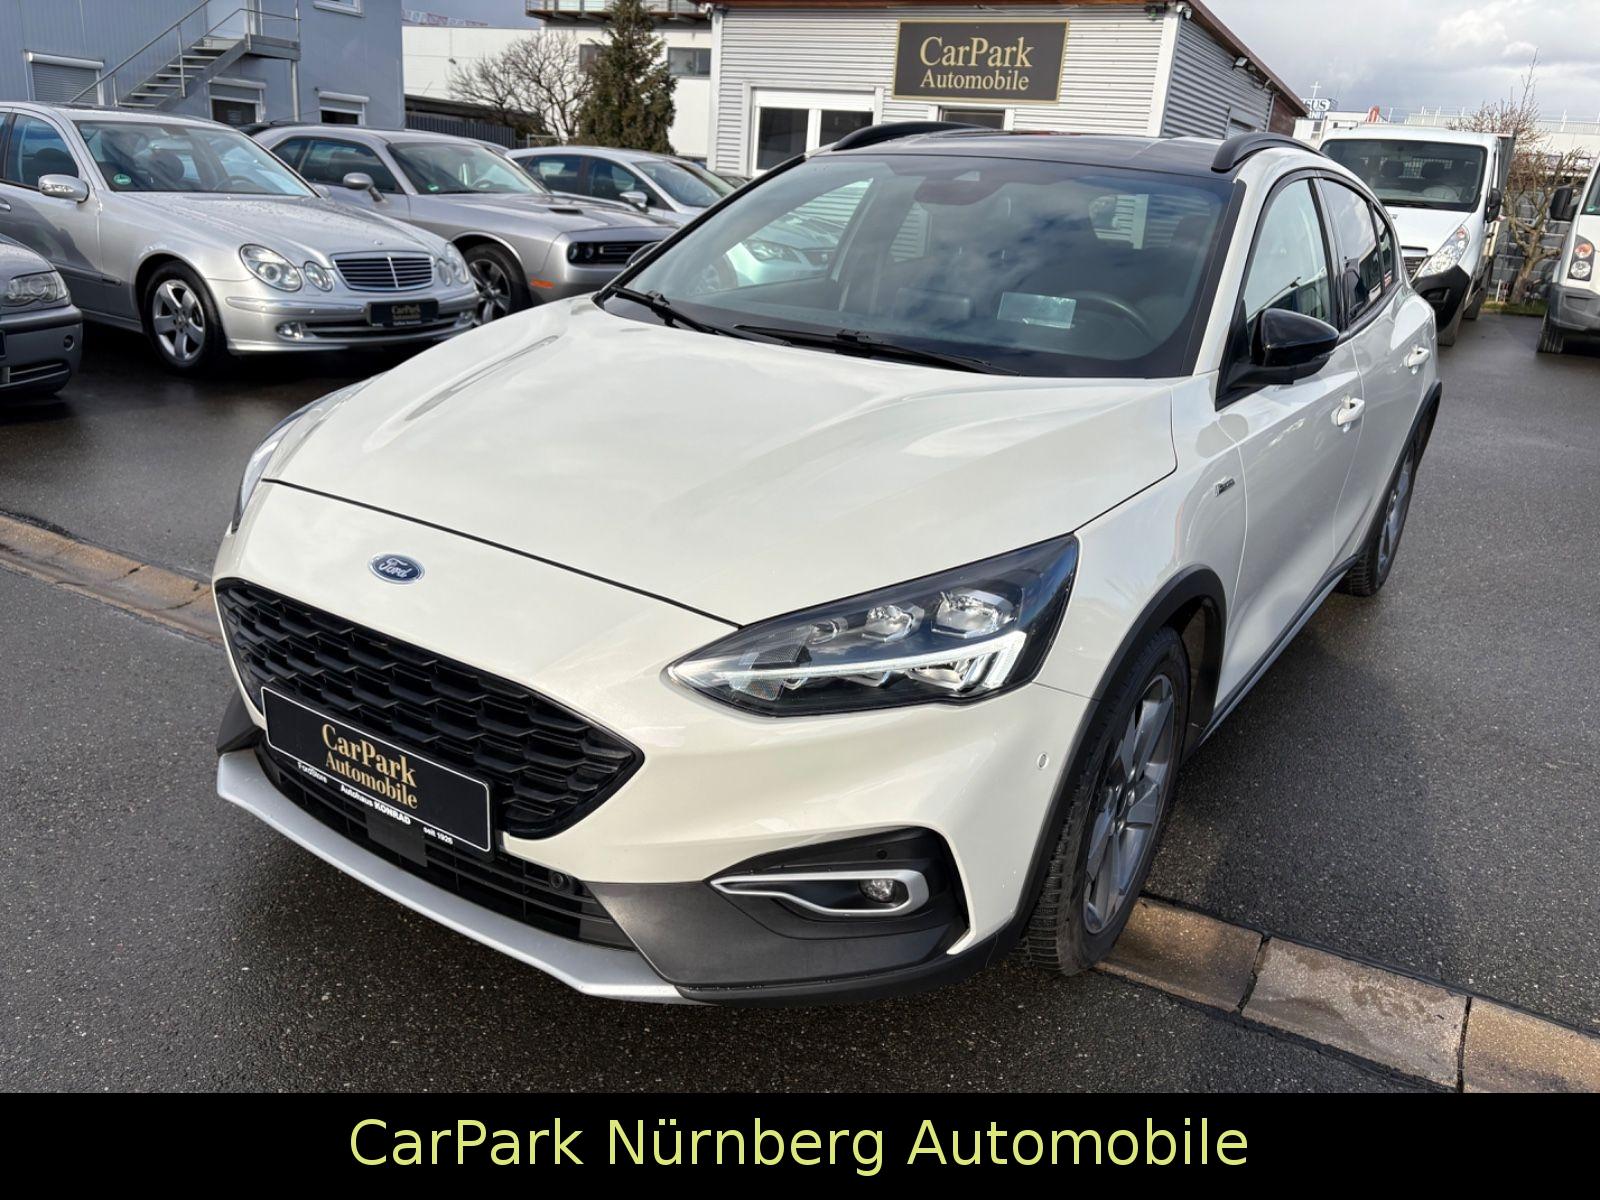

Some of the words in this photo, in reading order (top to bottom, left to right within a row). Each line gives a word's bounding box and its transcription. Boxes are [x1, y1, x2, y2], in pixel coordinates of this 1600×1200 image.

[919, 36, 1034, 68] CarPark
[919, 69, 1030, 91] Automobile
[378, 557, 413, 578] Ford
[321, 723, 418, 788] CarPark
[325, 751, 418, 809] Automobile
[340, 783, 374, 807] Autohaus
[374, 801, 412, 826] KONRAD
